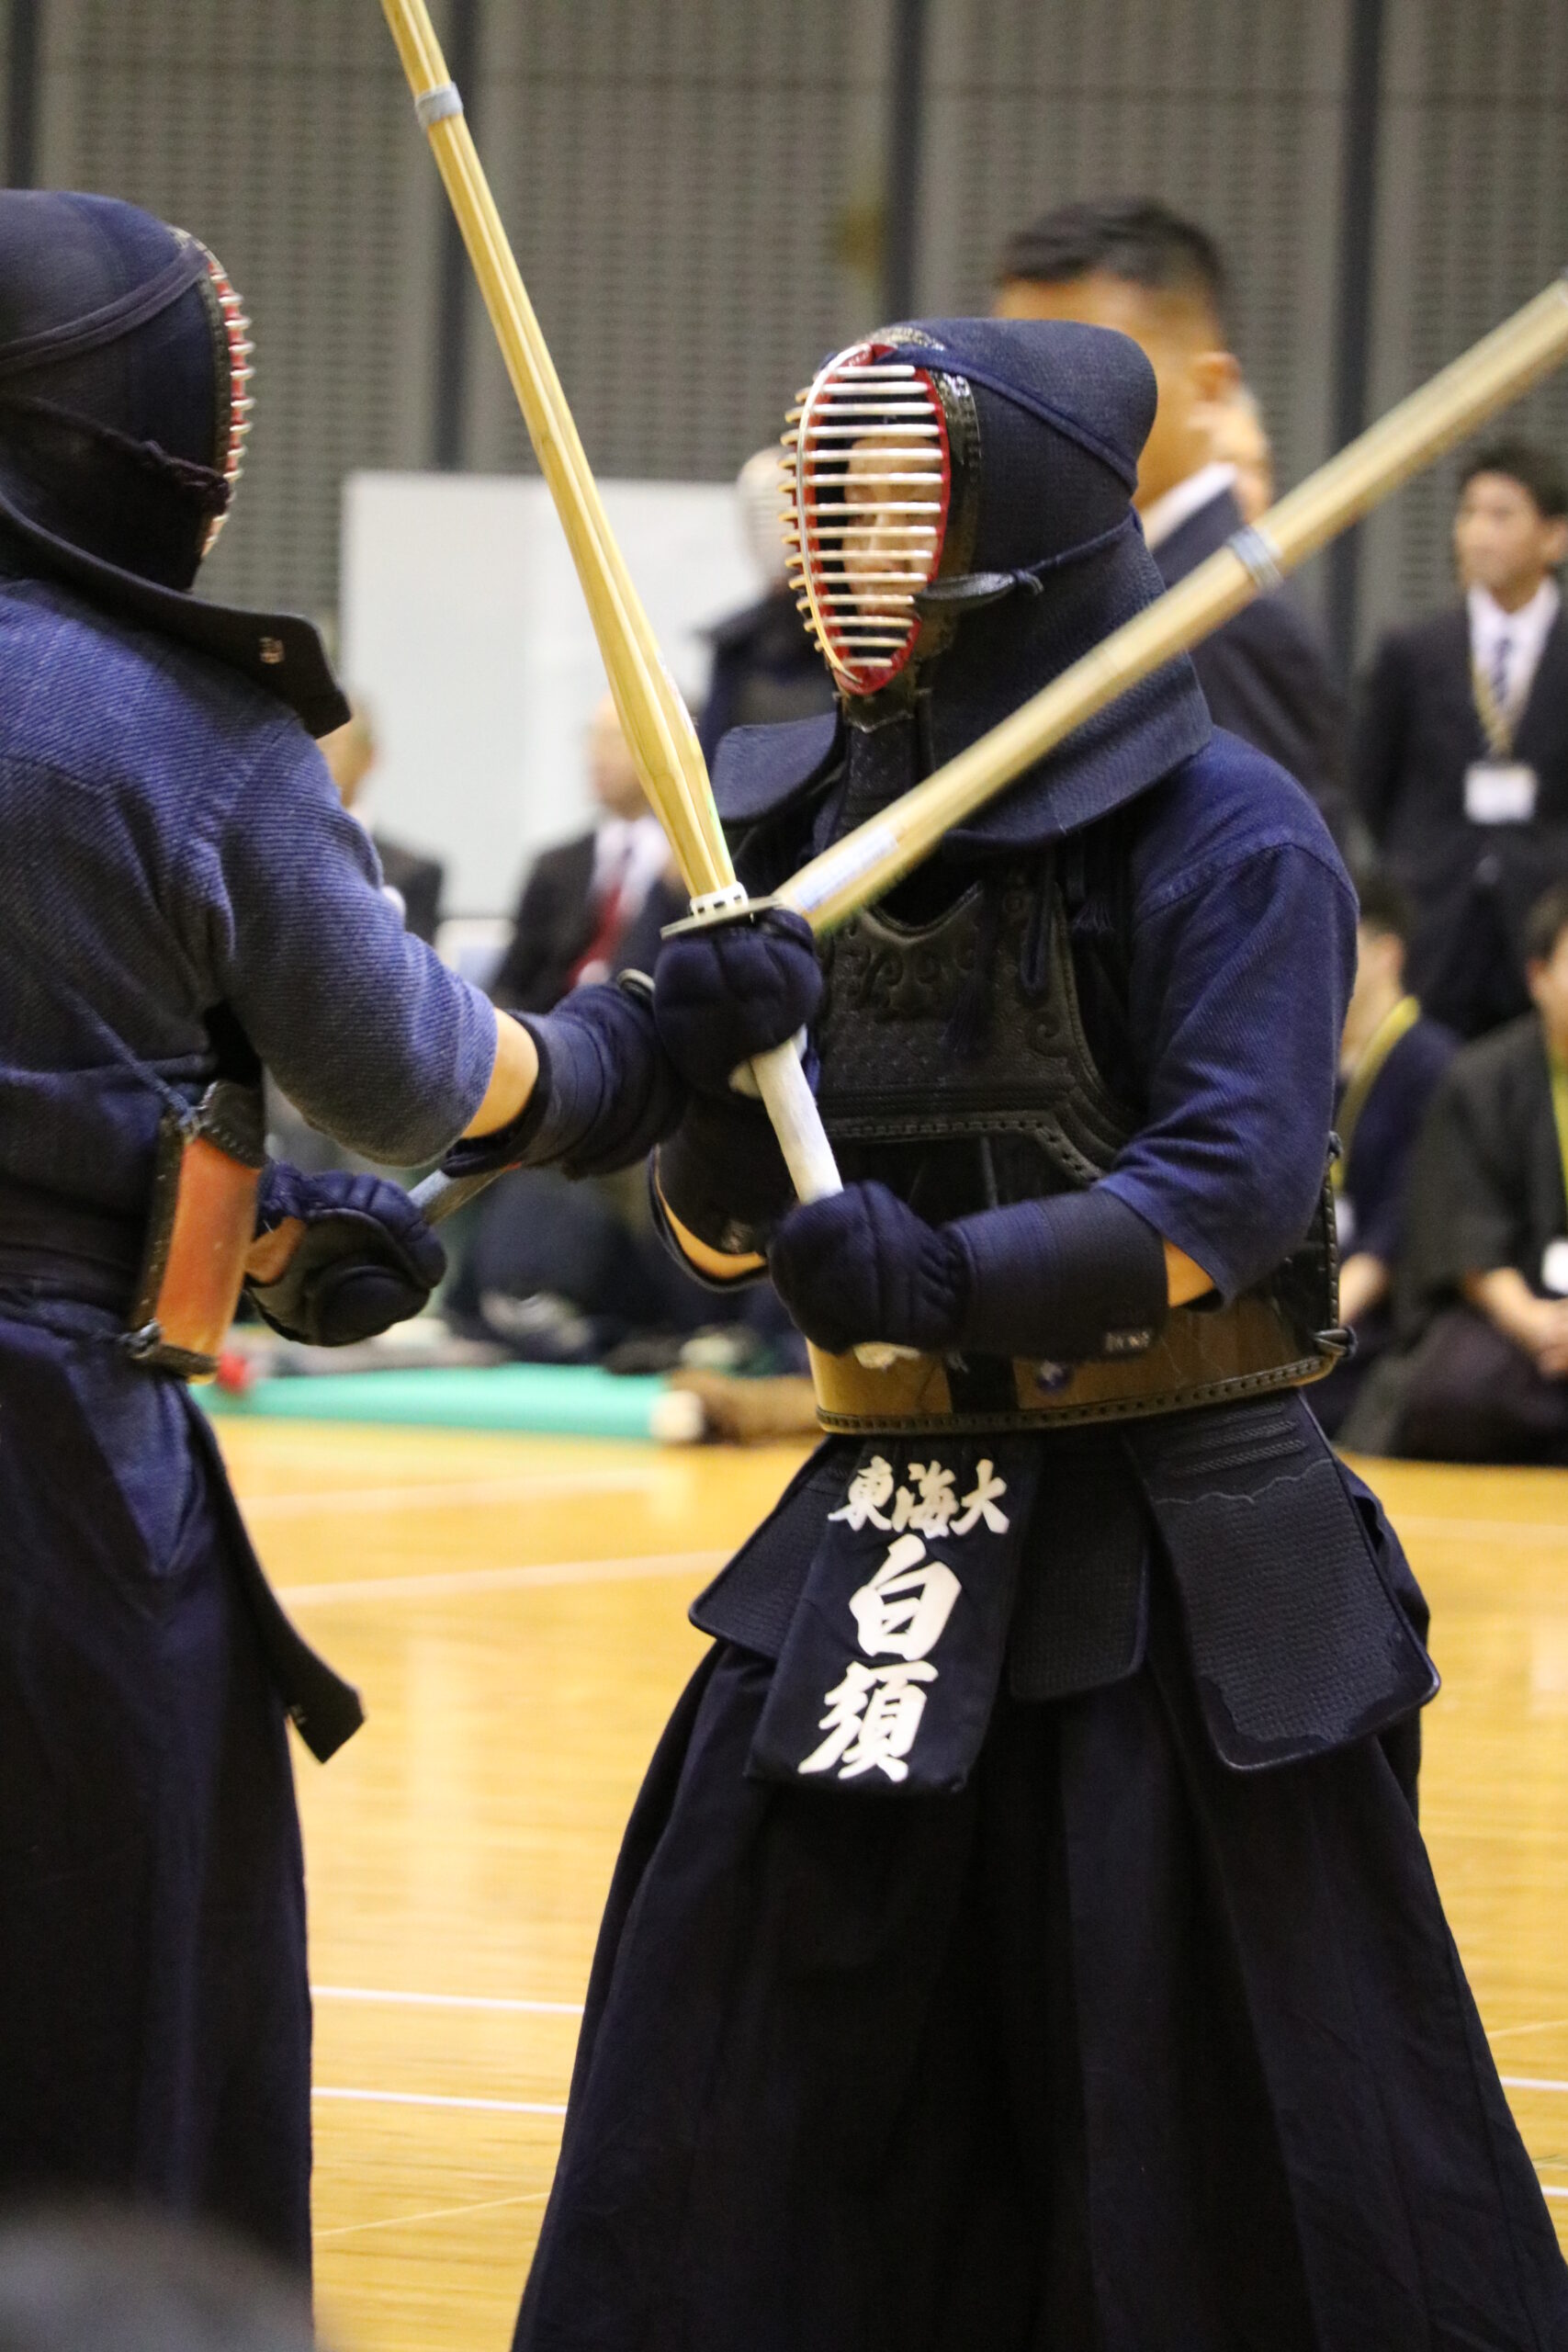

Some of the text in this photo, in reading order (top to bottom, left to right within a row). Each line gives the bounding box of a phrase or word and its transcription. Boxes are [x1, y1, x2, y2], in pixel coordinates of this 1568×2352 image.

[828, 1455, 1010, 1539] 東海大
[797, 1533, 962, 1782] 白須
